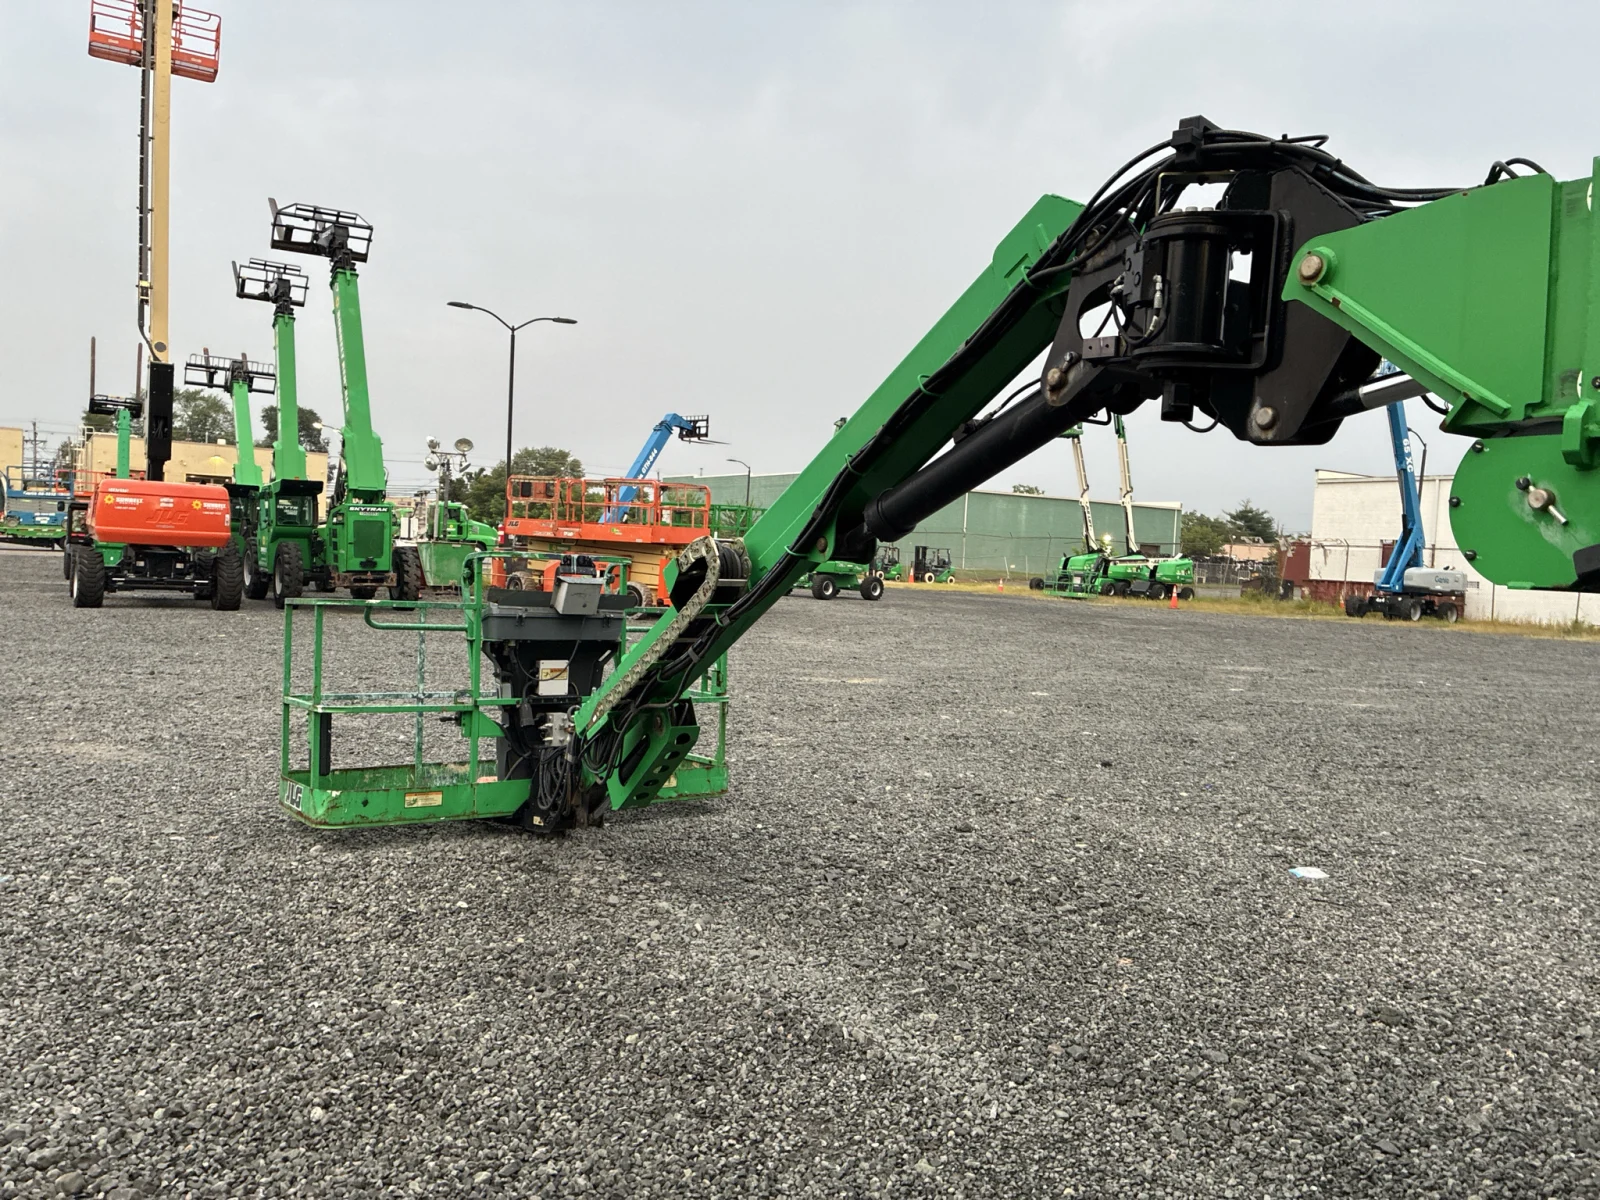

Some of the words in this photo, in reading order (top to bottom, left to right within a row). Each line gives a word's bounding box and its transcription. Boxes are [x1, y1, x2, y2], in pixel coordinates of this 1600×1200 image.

[1402, 438, 1411, 454] 65
[1405, 456, 1414, 473] XC
[1434, 575, 1450, 584] Genie
[285, 781, 303, 811] JLG
